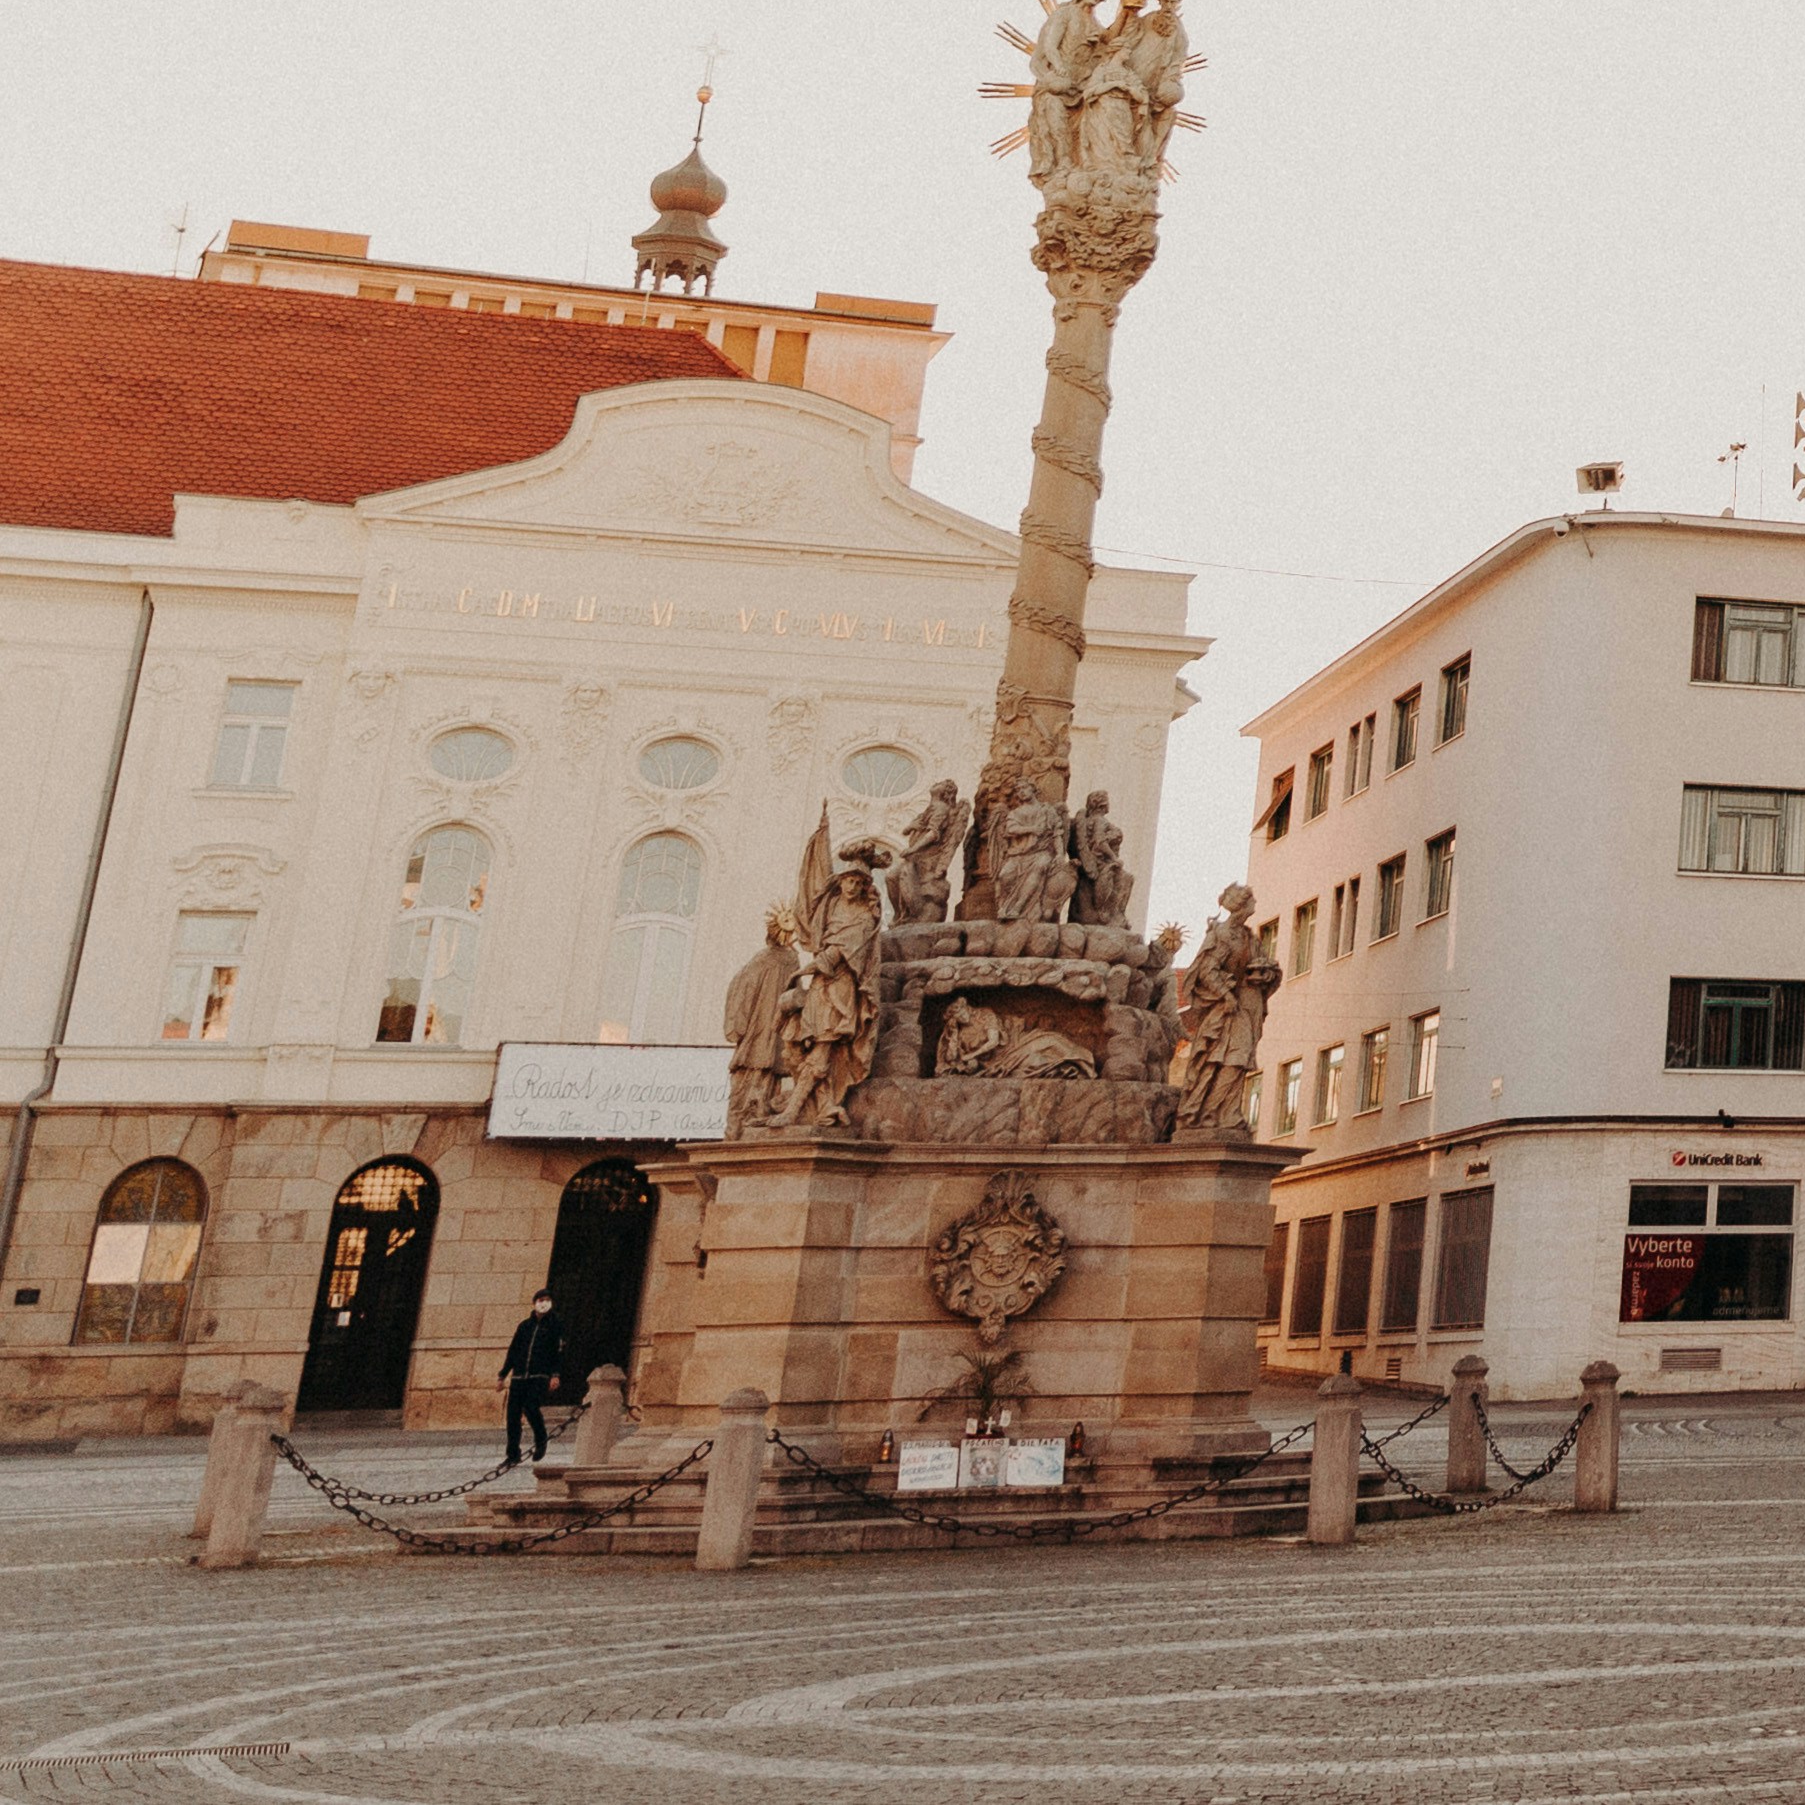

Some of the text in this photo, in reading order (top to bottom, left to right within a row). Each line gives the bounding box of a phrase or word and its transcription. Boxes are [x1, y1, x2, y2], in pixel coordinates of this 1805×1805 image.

[1688, 1153, 1763, 1167] UniCredit Bank
[1628, 1237, 1693, 1256] Vyberte
[1656, 1255, 1694, 1269] konto
